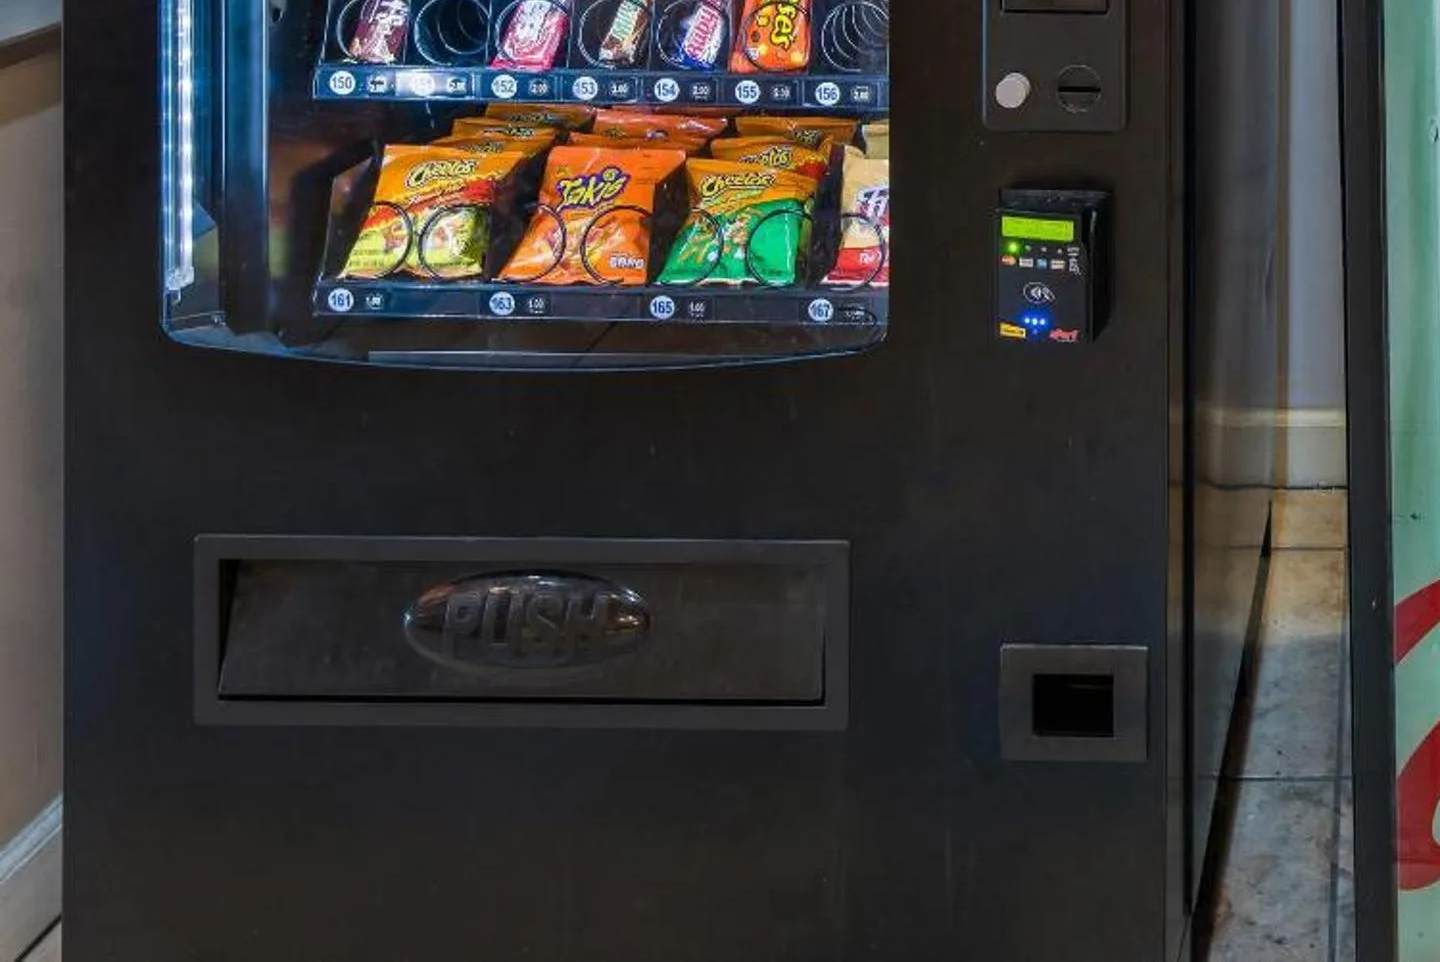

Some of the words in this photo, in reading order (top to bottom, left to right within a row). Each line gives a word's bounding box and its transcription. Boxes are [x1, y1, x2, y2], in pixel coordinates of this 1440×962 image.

[332, 76, 352, 89] 150
[494, 80, 514, 92] 152
[575, 82, 594, 94] 153
[657, 83, 676, 96] 154
[738, 86, 757, 99] 155
[818, 88, 837, 100] 156
[332, 293, 350, 307] 161
[653, 300, 672, 314] 165
